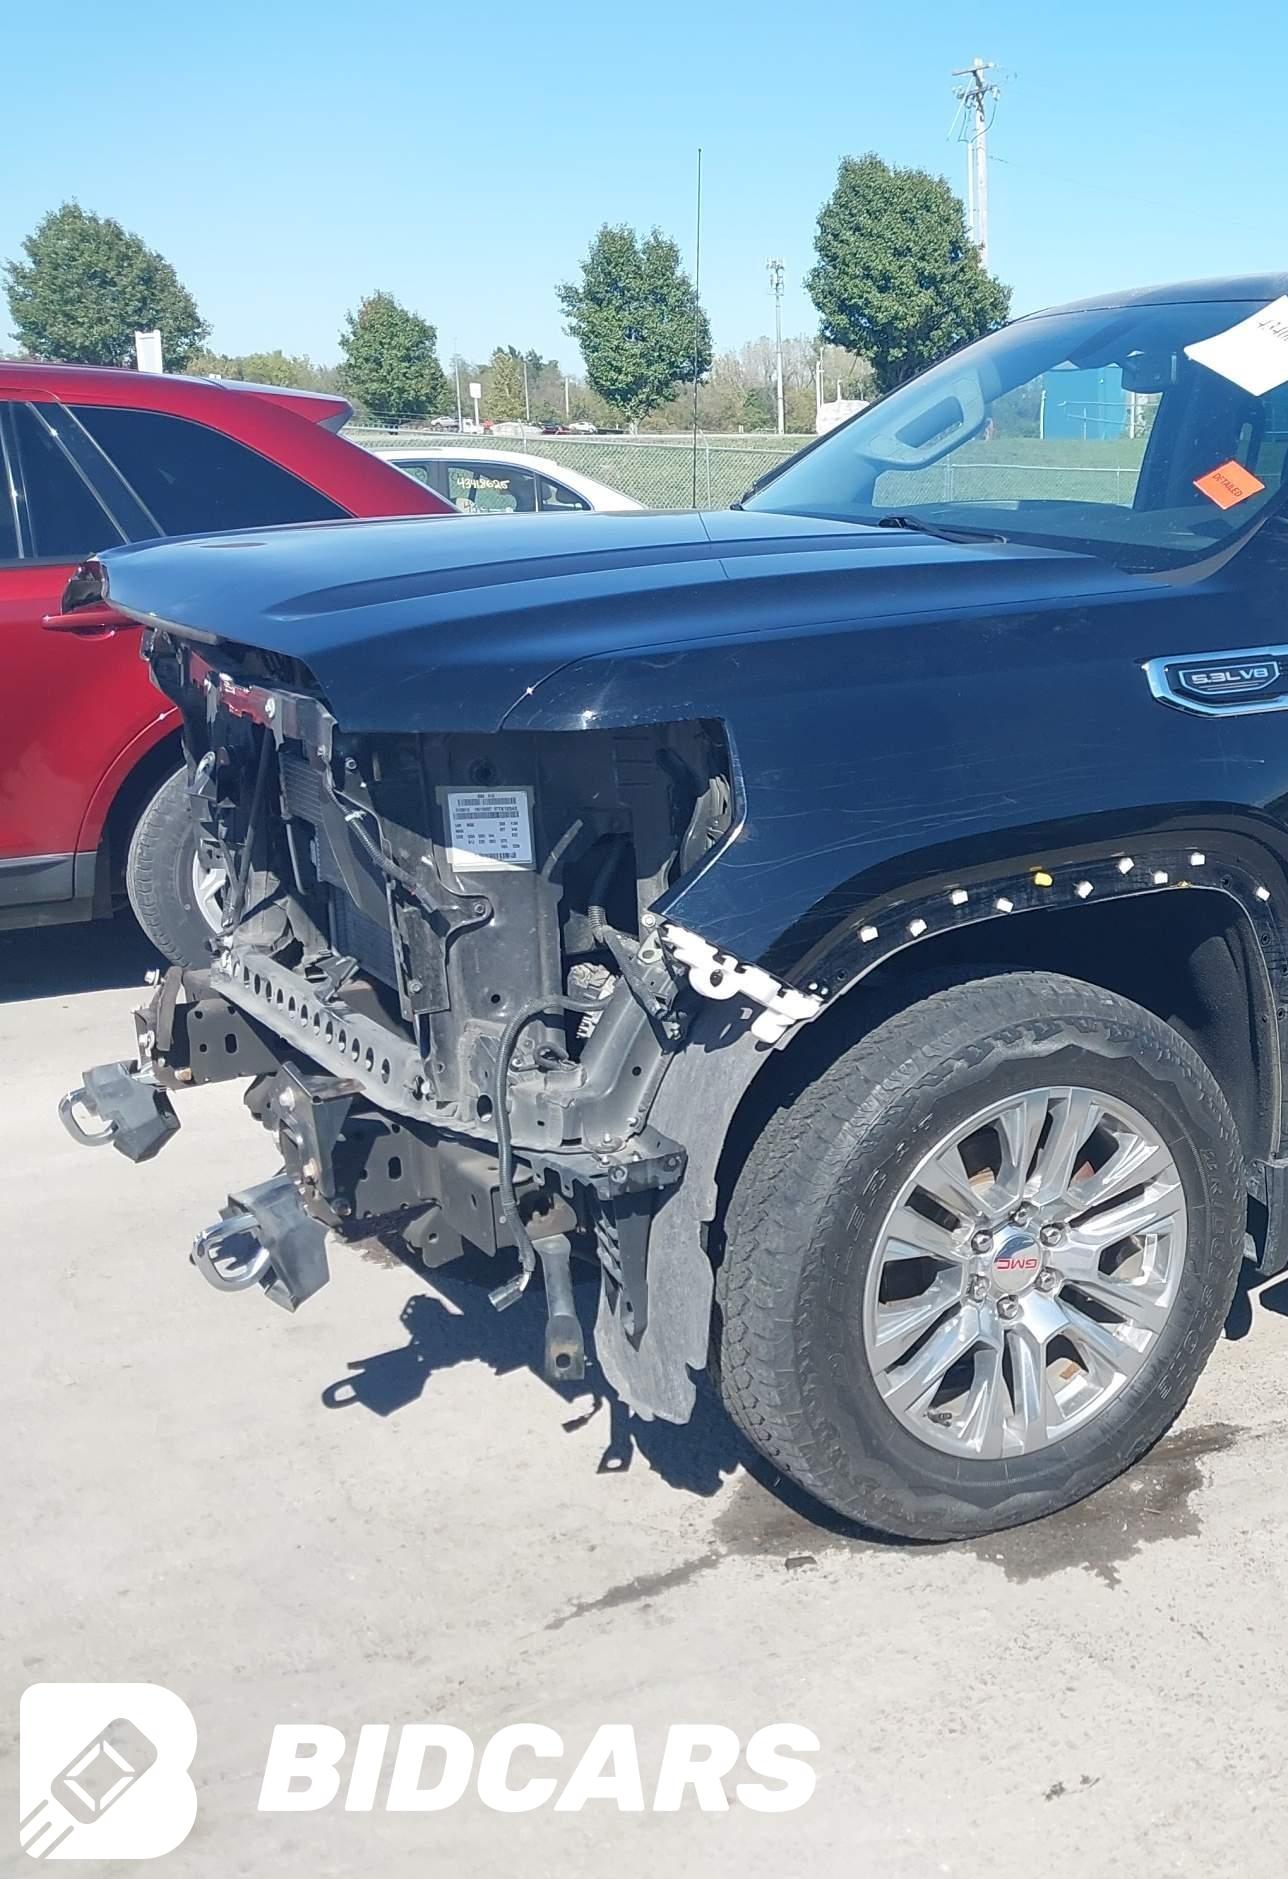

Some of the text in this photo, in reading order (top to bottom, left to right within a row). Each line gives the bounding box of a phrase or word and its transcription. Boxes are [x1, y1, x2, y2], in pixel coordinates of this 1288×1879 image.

[457, 477, 511, 490] 43418625
[1212, 473, 1243, 497] DETAILED
[997, 1258, 1037, 1270] GMC
